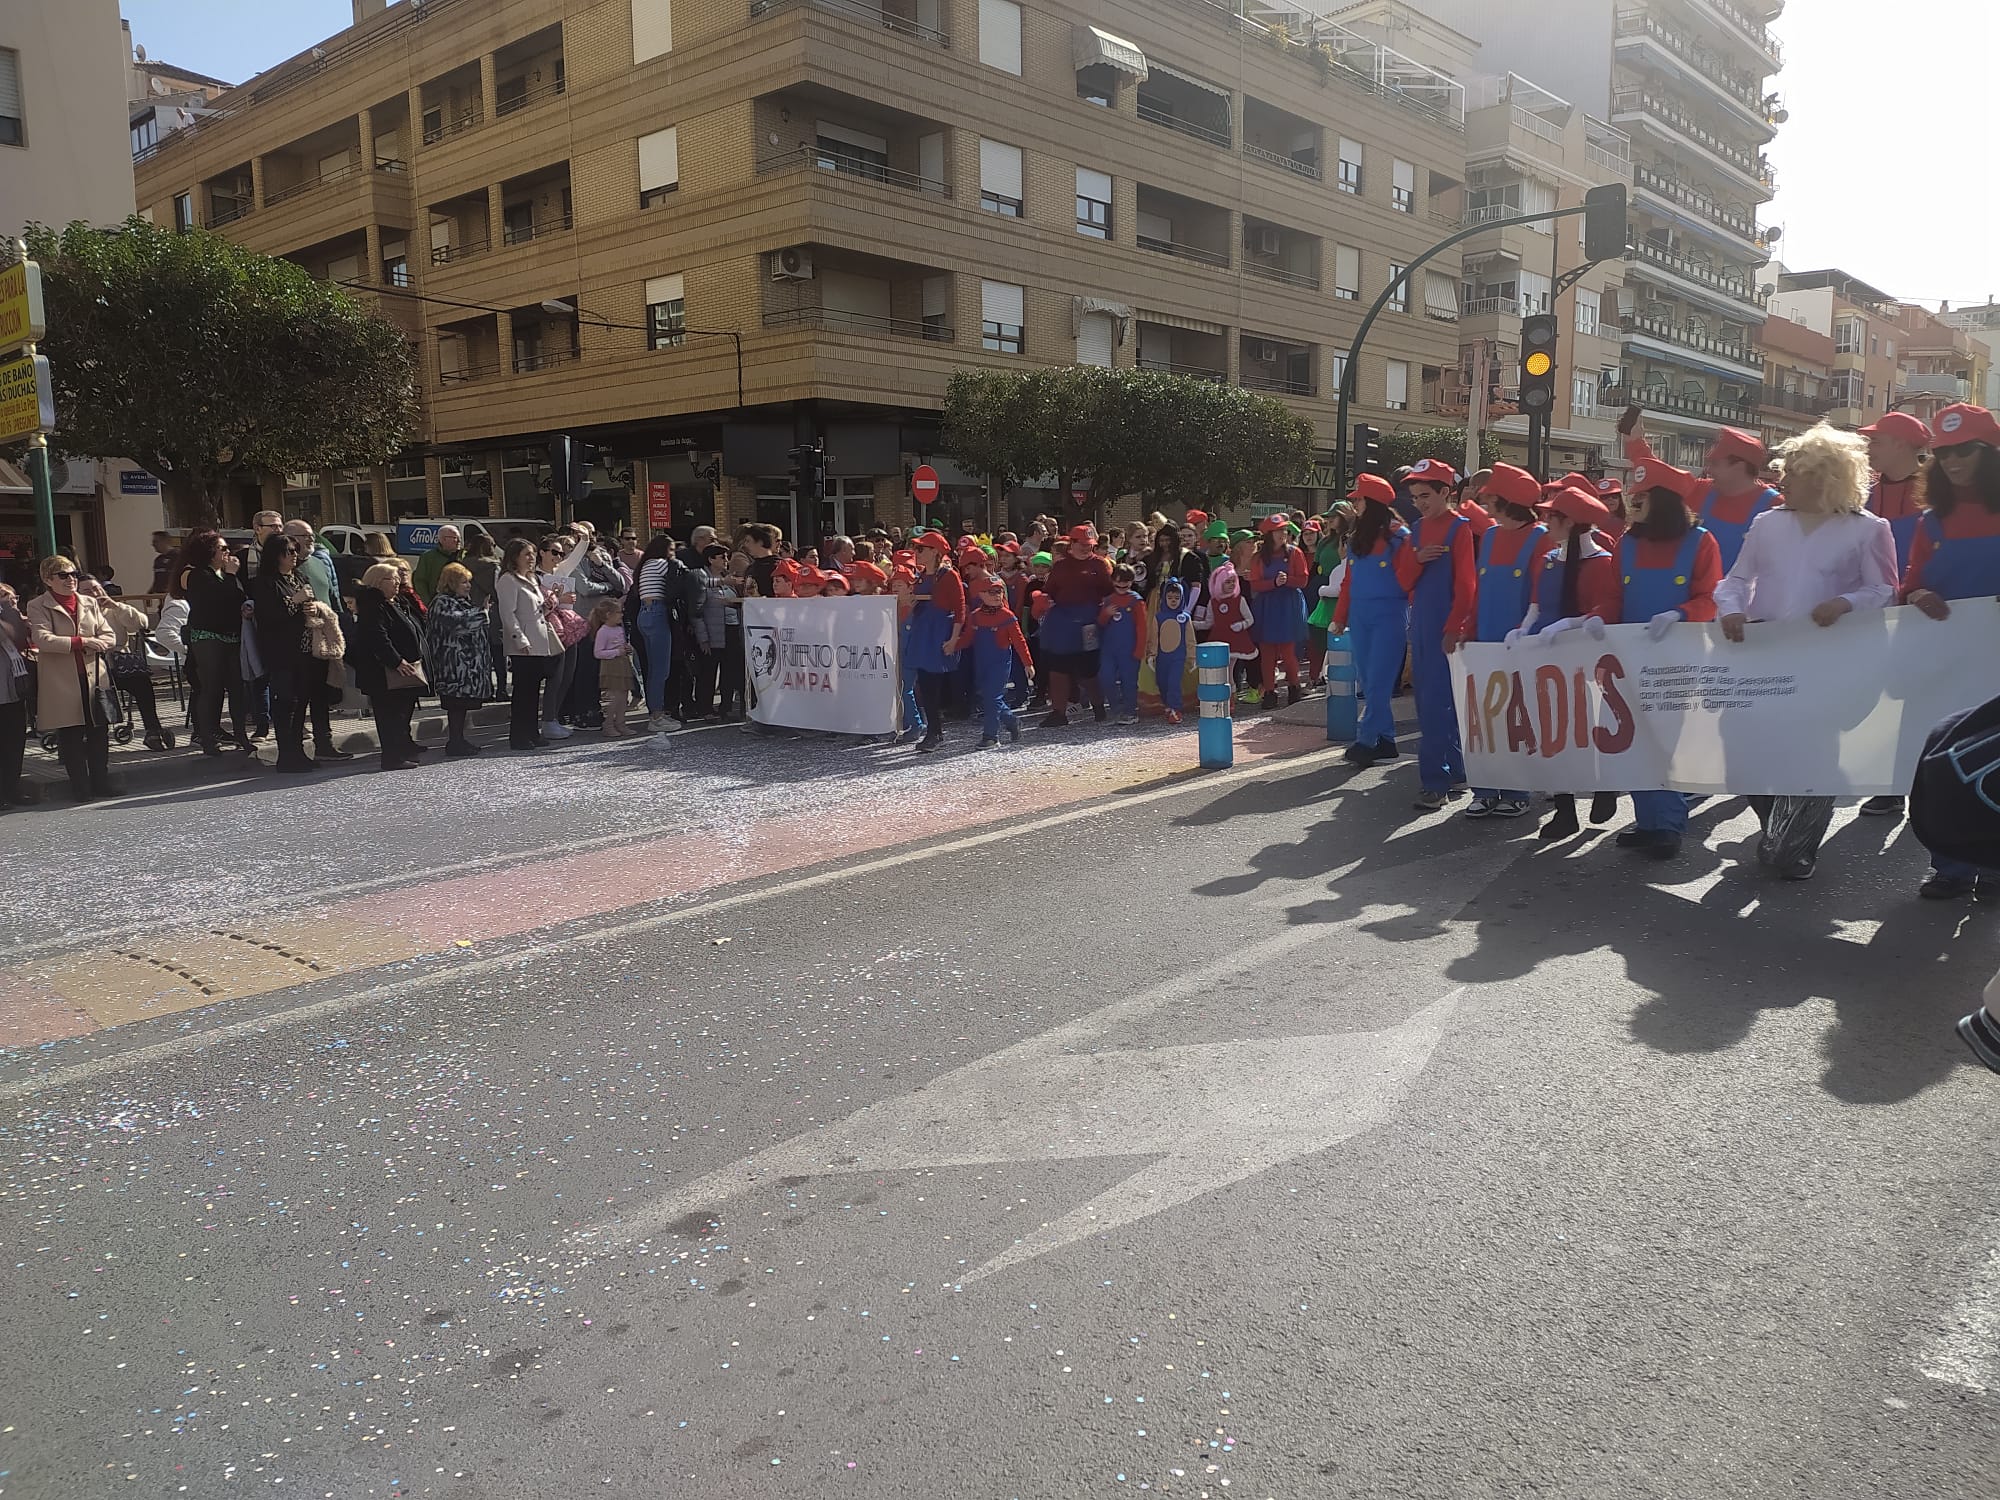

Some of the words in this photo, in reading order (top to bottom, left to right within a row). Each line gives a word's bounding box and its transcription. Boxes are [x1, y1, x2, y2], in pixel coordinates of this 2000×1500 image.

[3, 370, 12, 385] DE
[13, 363, 33, 383] BAÑO
[8, 381, 36, 400] DUCHAS
[1700, 664, 1730, 675] para
[780, 671, 833, 693] AMPA
[1466, 654, 1635, 758] APADIS
